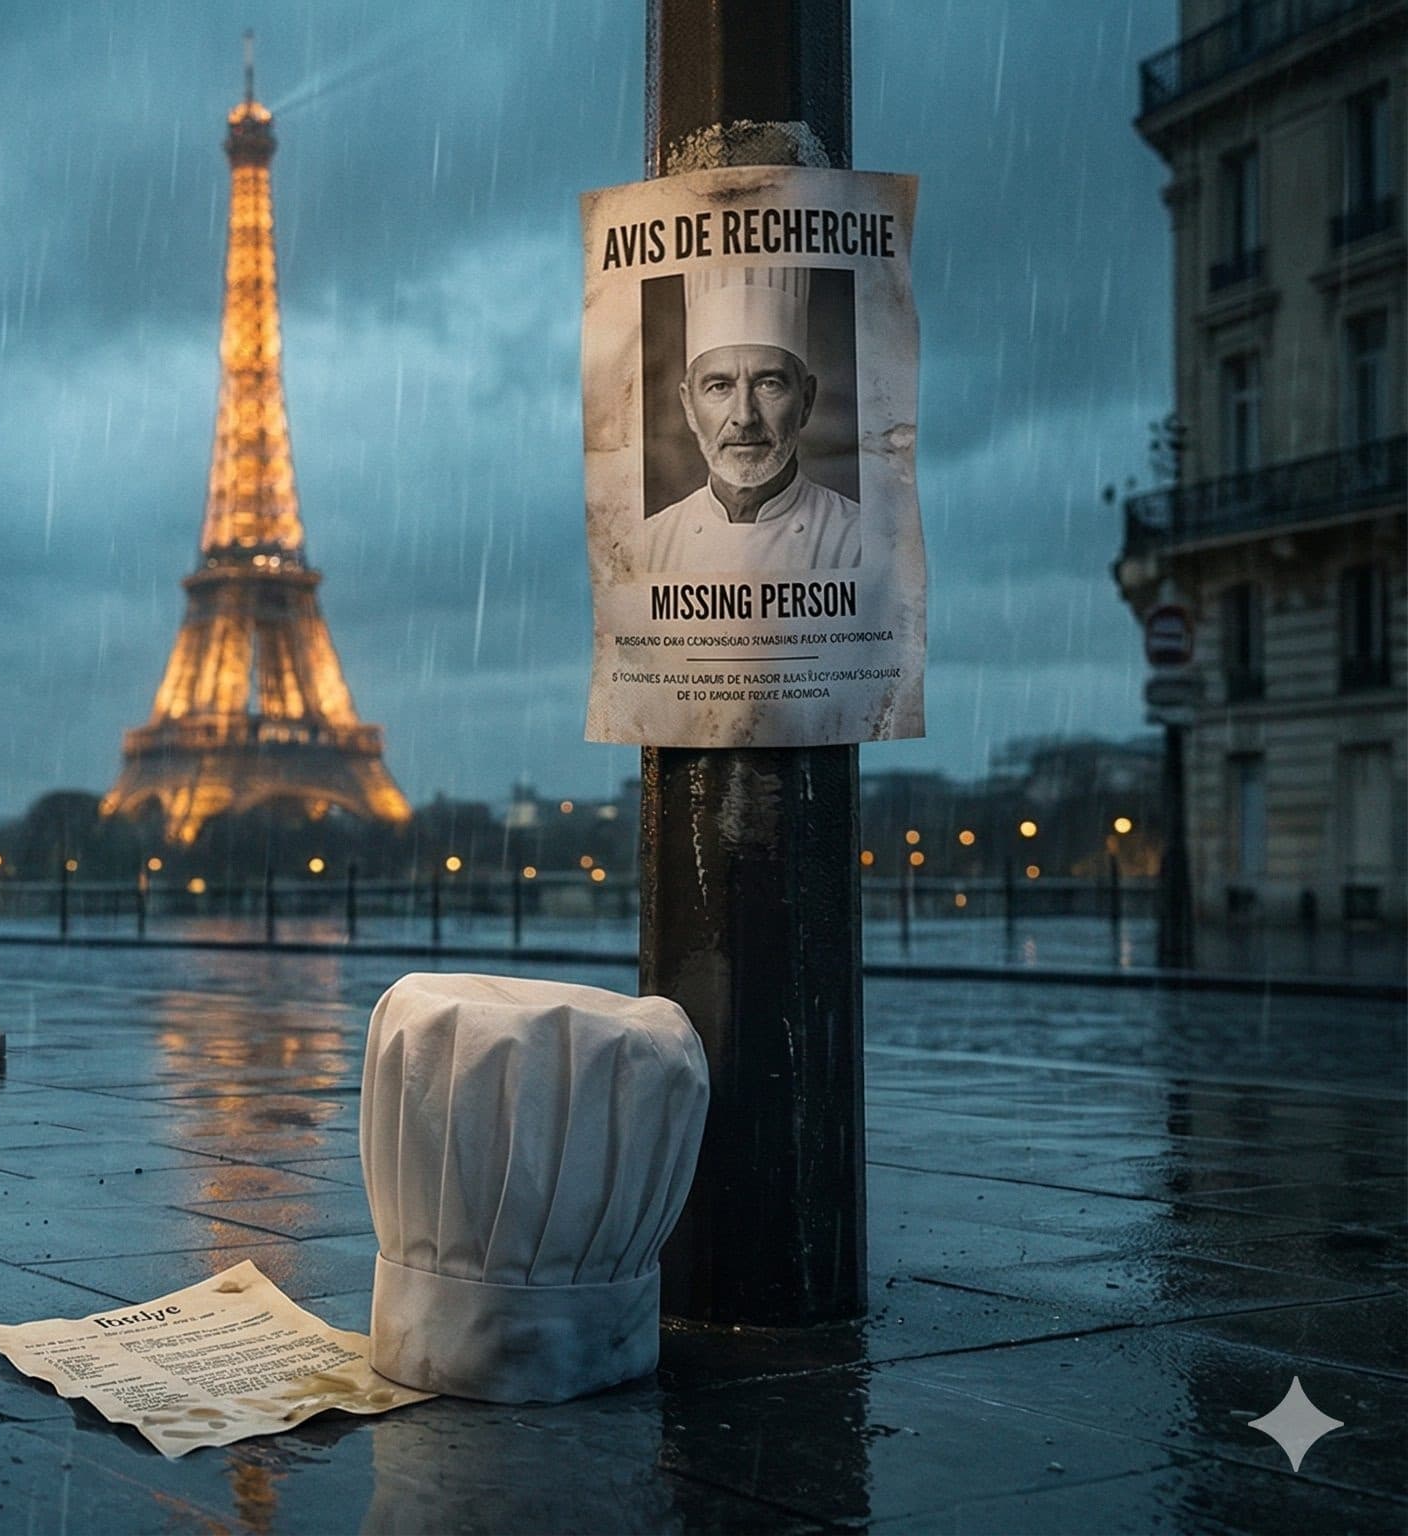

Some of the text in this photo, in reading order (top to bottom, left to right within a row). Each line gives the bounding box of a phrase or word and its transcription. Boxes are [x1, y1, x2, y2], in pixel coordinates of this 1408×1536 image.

[602, 207, 896, 271] AVIS DE RECHERCHE
[651, 580, 857, 621] MISSING PERSON
[727, 674, 742, 685] DE
[676, 690, 691, 701] DE
